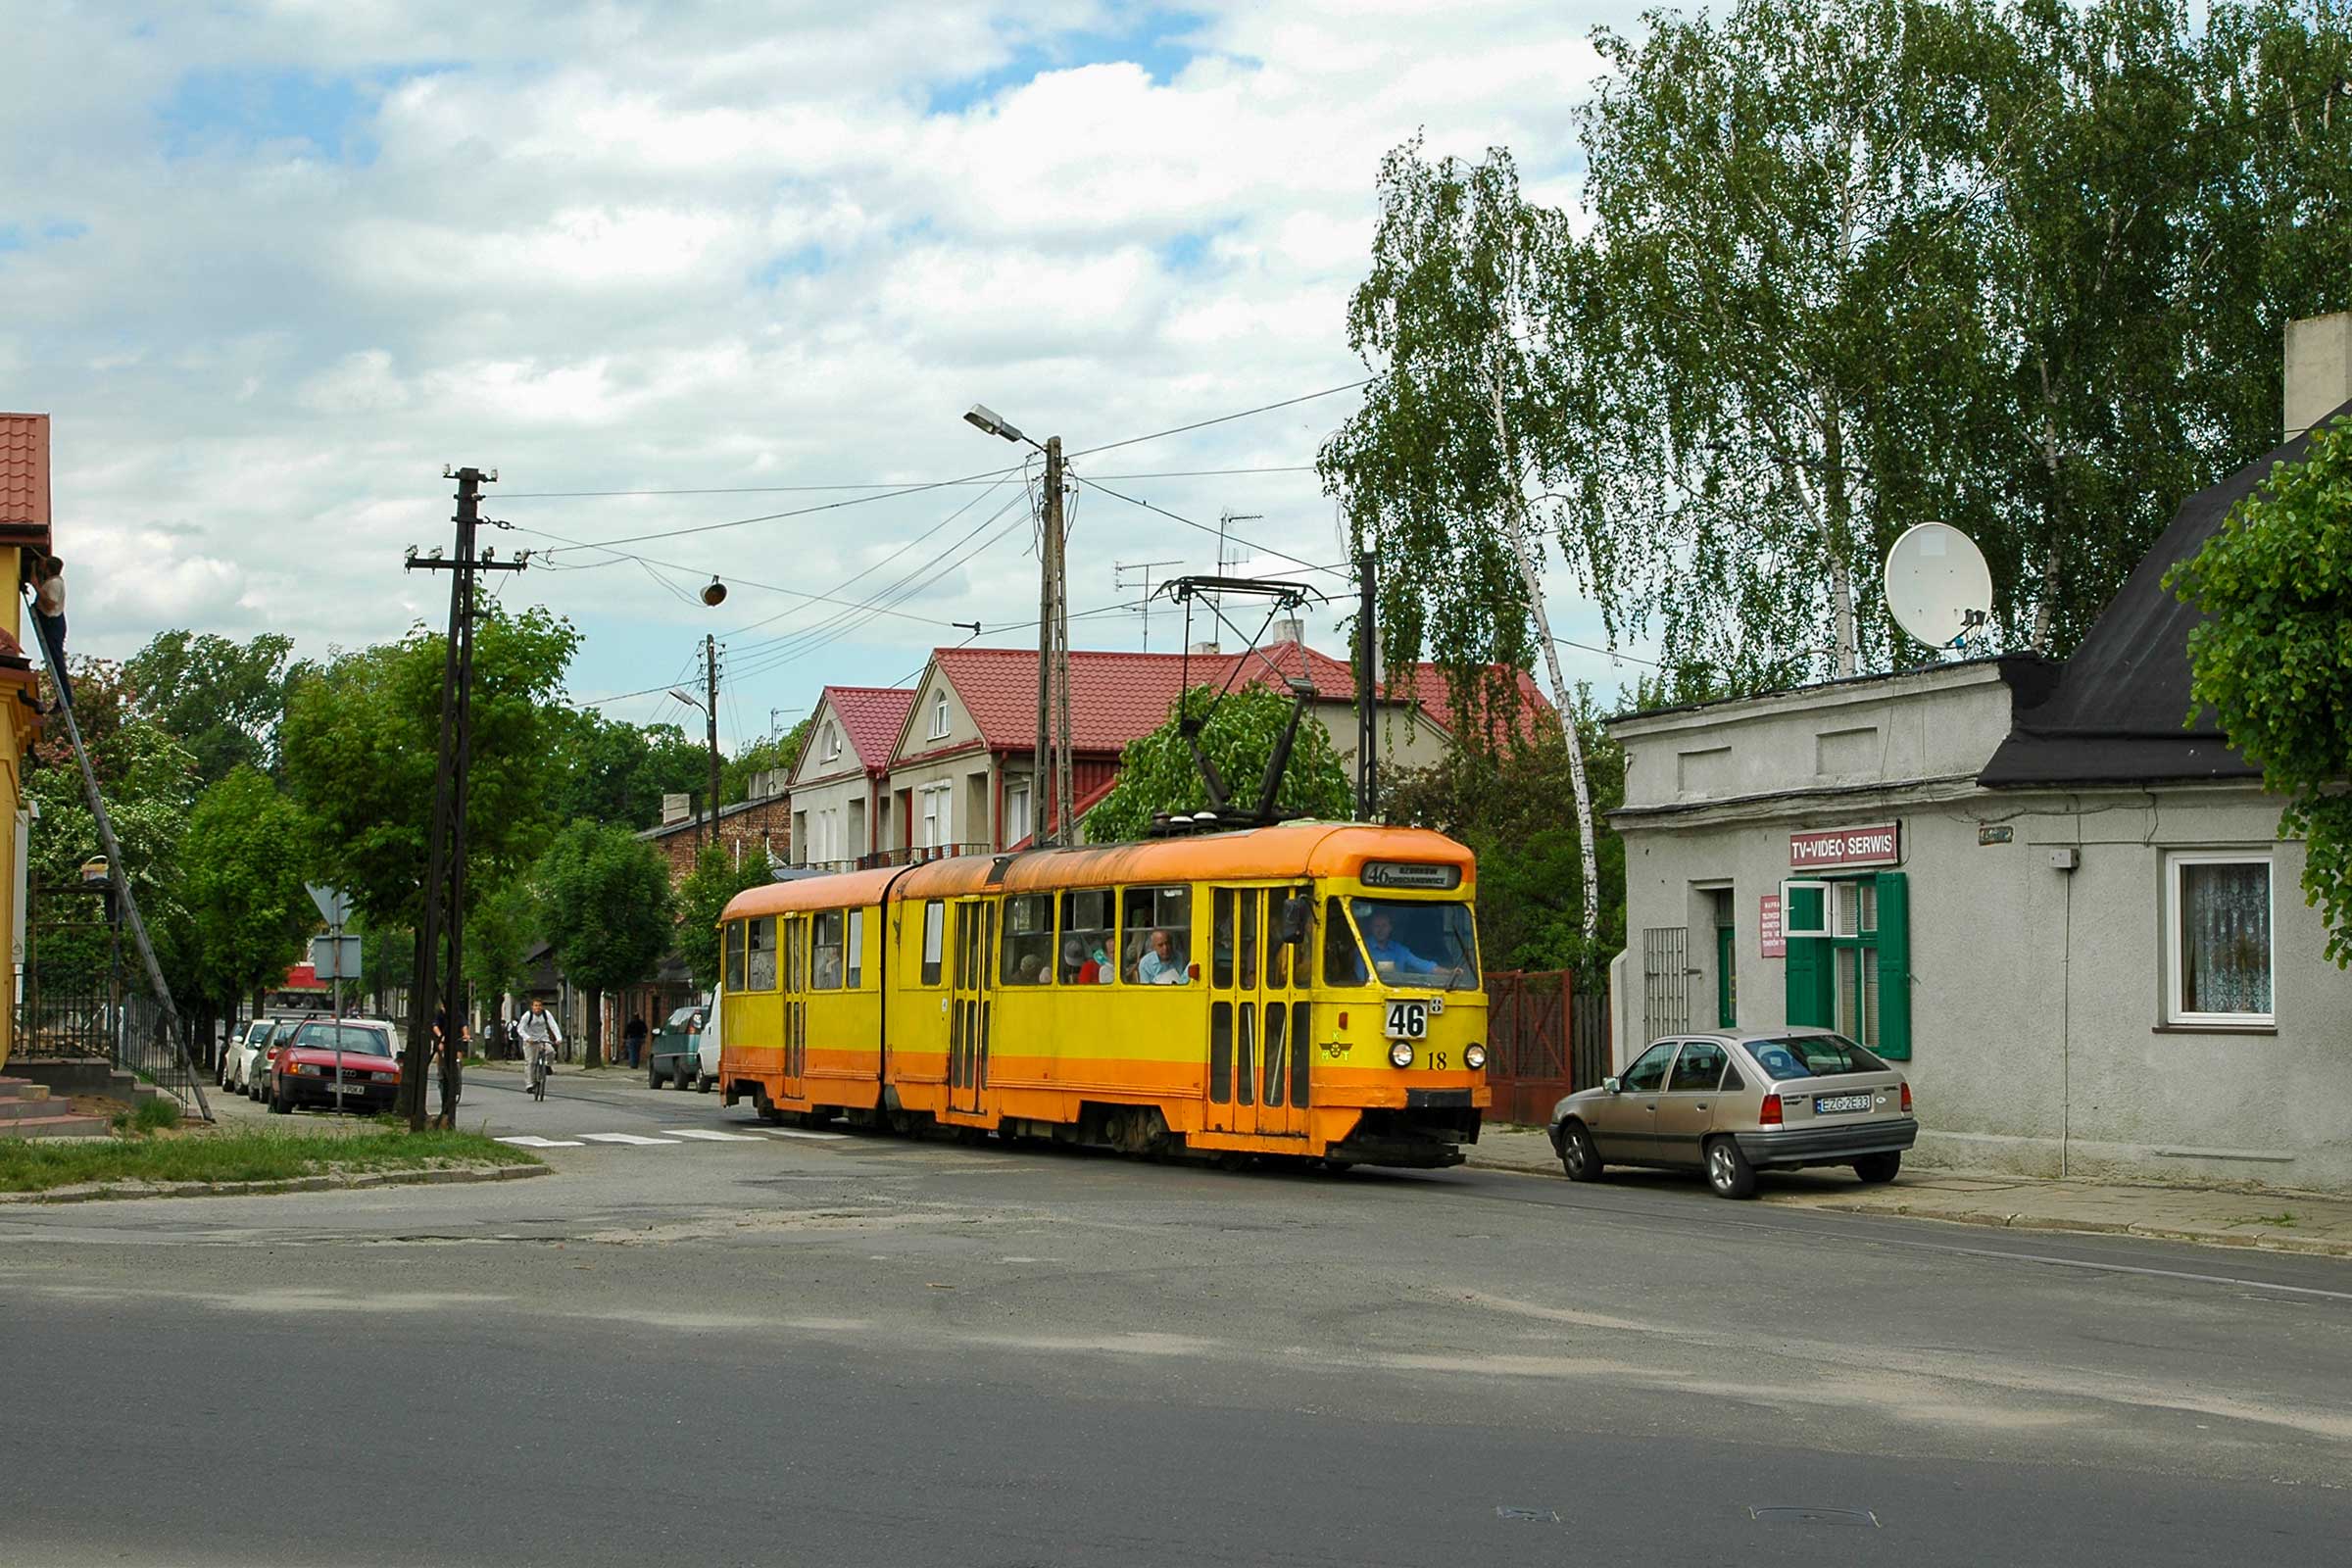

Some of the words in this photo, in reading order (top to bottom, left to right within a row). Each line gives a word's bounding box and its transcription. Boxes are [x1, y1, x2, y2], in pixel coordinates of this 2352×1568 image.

[1791, 838, 1844, 859] TV-VIDEO
[1847, 834, 1892, 855] SERWIS
[1367, 864, 1389, 885] 46
[1388, 1004, 1425, 1037] 46
[1428, 1052, 1446, 1070] 18
